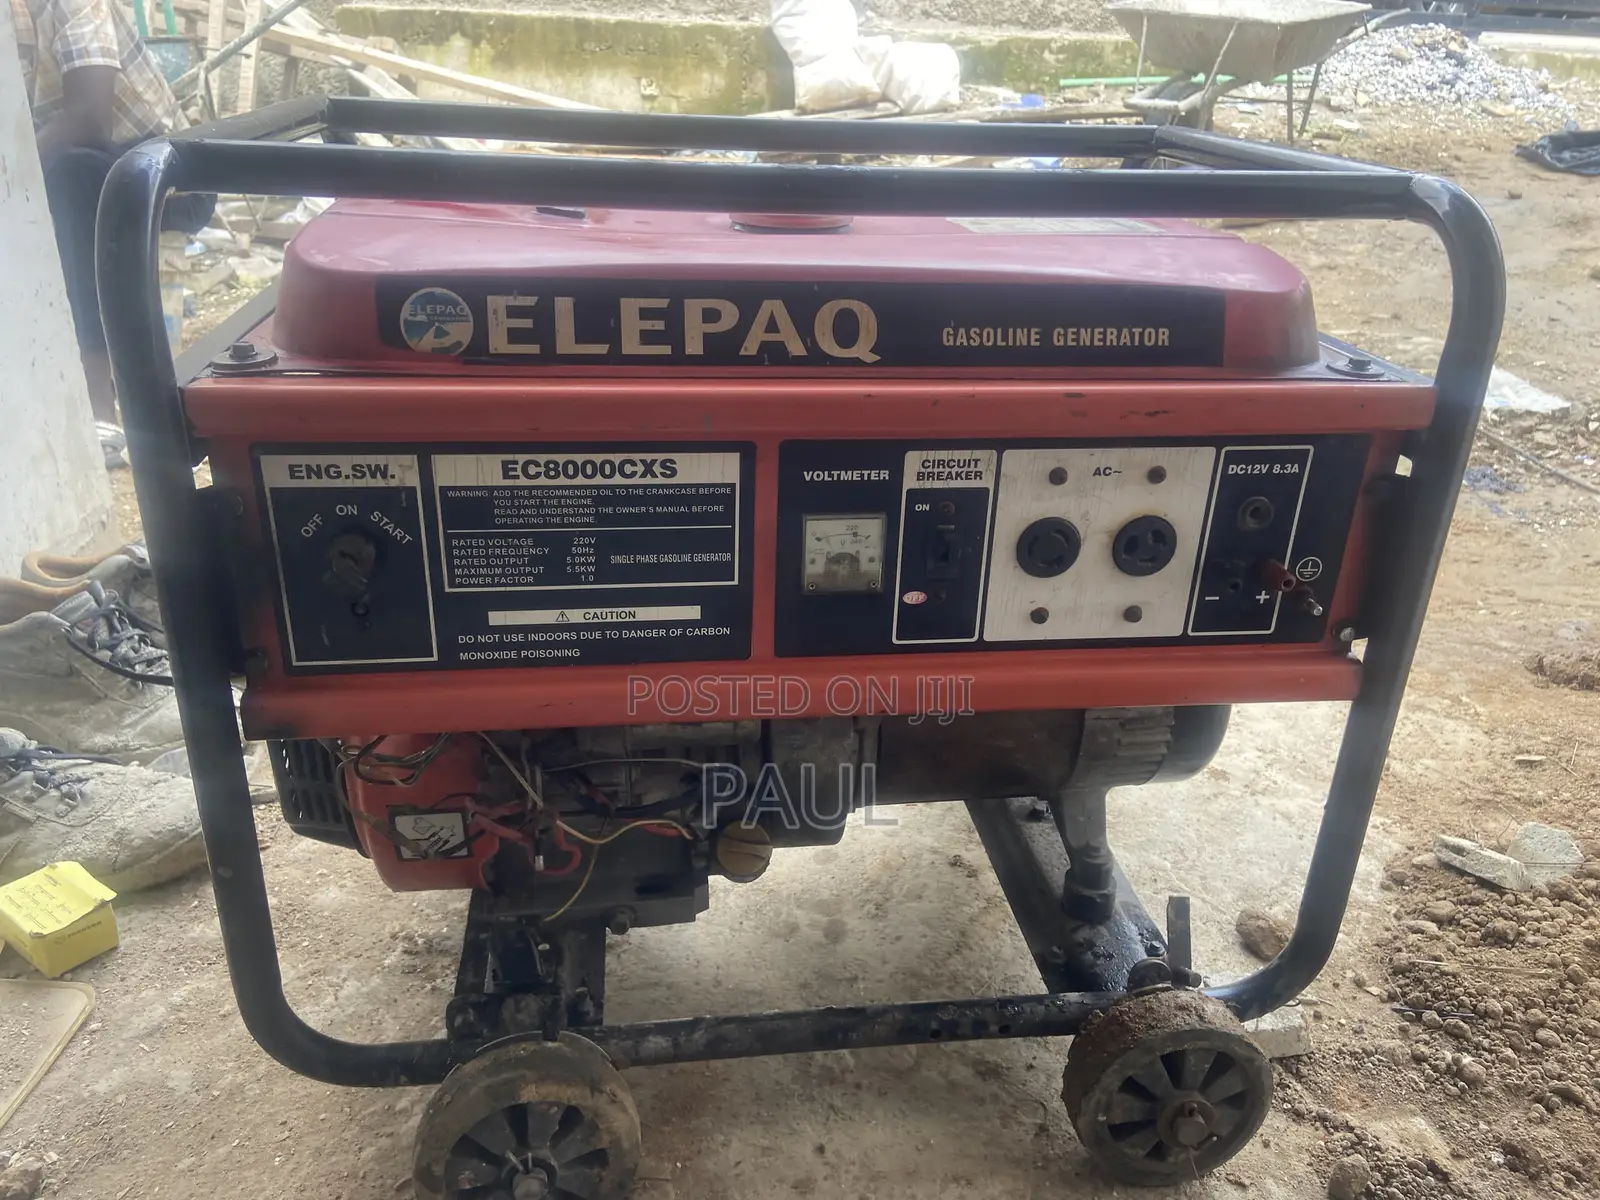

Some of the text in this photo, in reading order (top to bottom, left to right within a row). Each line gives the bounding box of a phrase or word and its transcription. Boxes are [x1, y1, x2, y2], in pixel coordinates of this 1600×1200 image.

[486, 294, 882, 363] ELEPAQ
[942, 327, 1170, 347] GASOLINE GENERATOR
[501, 458, 678, 480] EC8000CXS
[921, 458, 981, 469] CIRCUIT
[1228, 463, 1299, 475] DC12V 8.3A
[288, 463, 396, 480] ENG.SW.
[803, 470, 890, 481] VOLTMETER
[916, 470, 983, 482] BREAKER
[699, 487, 732, 495] BEFORE
[335, 504, 358, 516] ON
[540, 507, 596, 515] UNDERSTAND
[301, 513, 324, 538] OFF
[370, 511, 413, 545] START
[452, 538, 534, 547] RATED VOLTAGE
[573, 537, 596, 545] 220V
[453, 547, 550, 556] RATED FREQUENCY
[571, 546, 595, 554] 50Hz
[453, 557, 529, 566] RATED OUTPUT
[566, 556, 596, 564] 5.0KW
[610, 552, 732, 564] SINGLE PHASE GASOLINE GENERATOR
[454, 566, 545, 575] MAXIMUM OUTPUT
[566, 565, 596, 573] 5.5KW
[455, 576, 534, 585] POWER FACTOR
[583, 610, 636, 621] CAUTION
[458, 627, 730, 644] DO NOT USE INDOORS DUE TO DANGER OF CARBON
[460, 649, 580, 661] MONOXIDE POISONING
